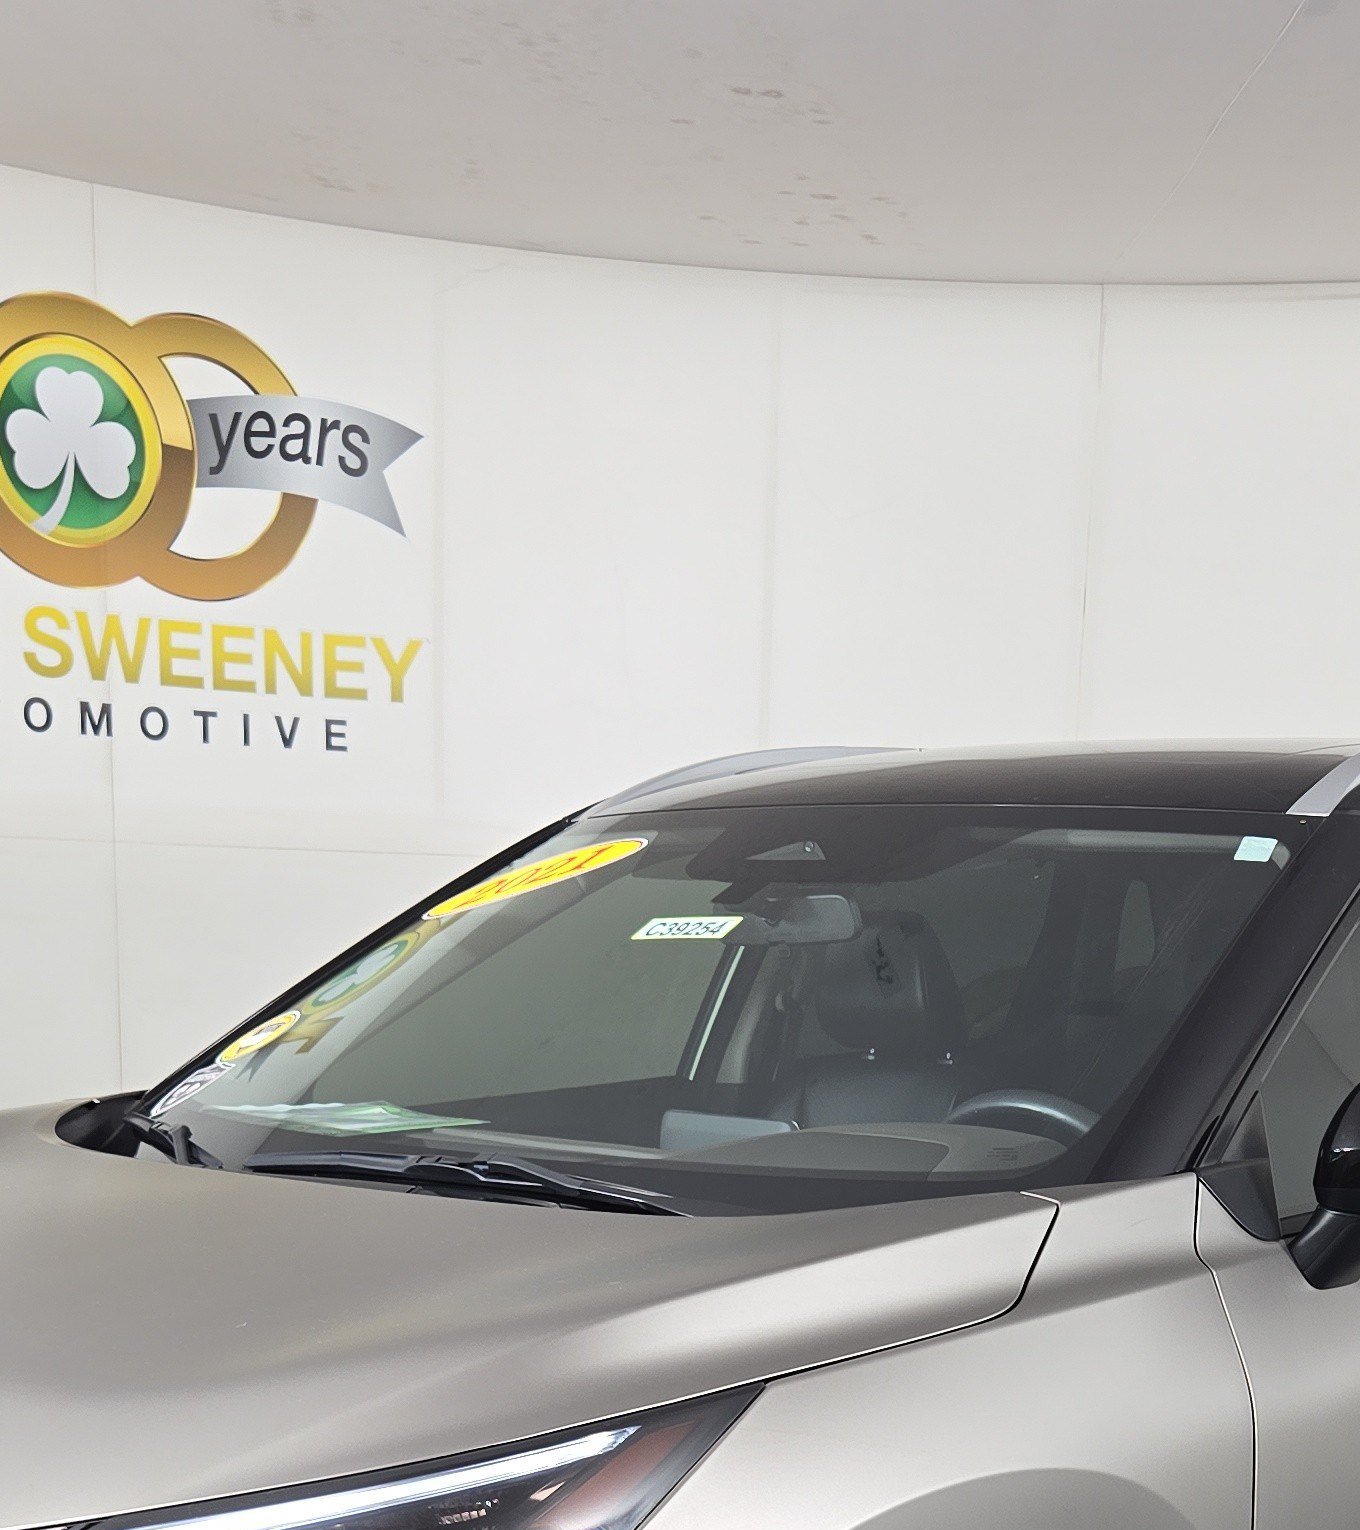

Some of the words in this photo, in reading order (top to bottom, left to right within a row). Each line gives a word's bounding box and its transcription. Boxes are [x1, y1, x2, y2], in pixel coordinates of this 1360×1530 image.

[208, 409, 370, 478] years
[22, 604, 424, 703] SWEENEY
[455, 844, 614, 908] 2021
[646, 920, 729, 936] C39254
